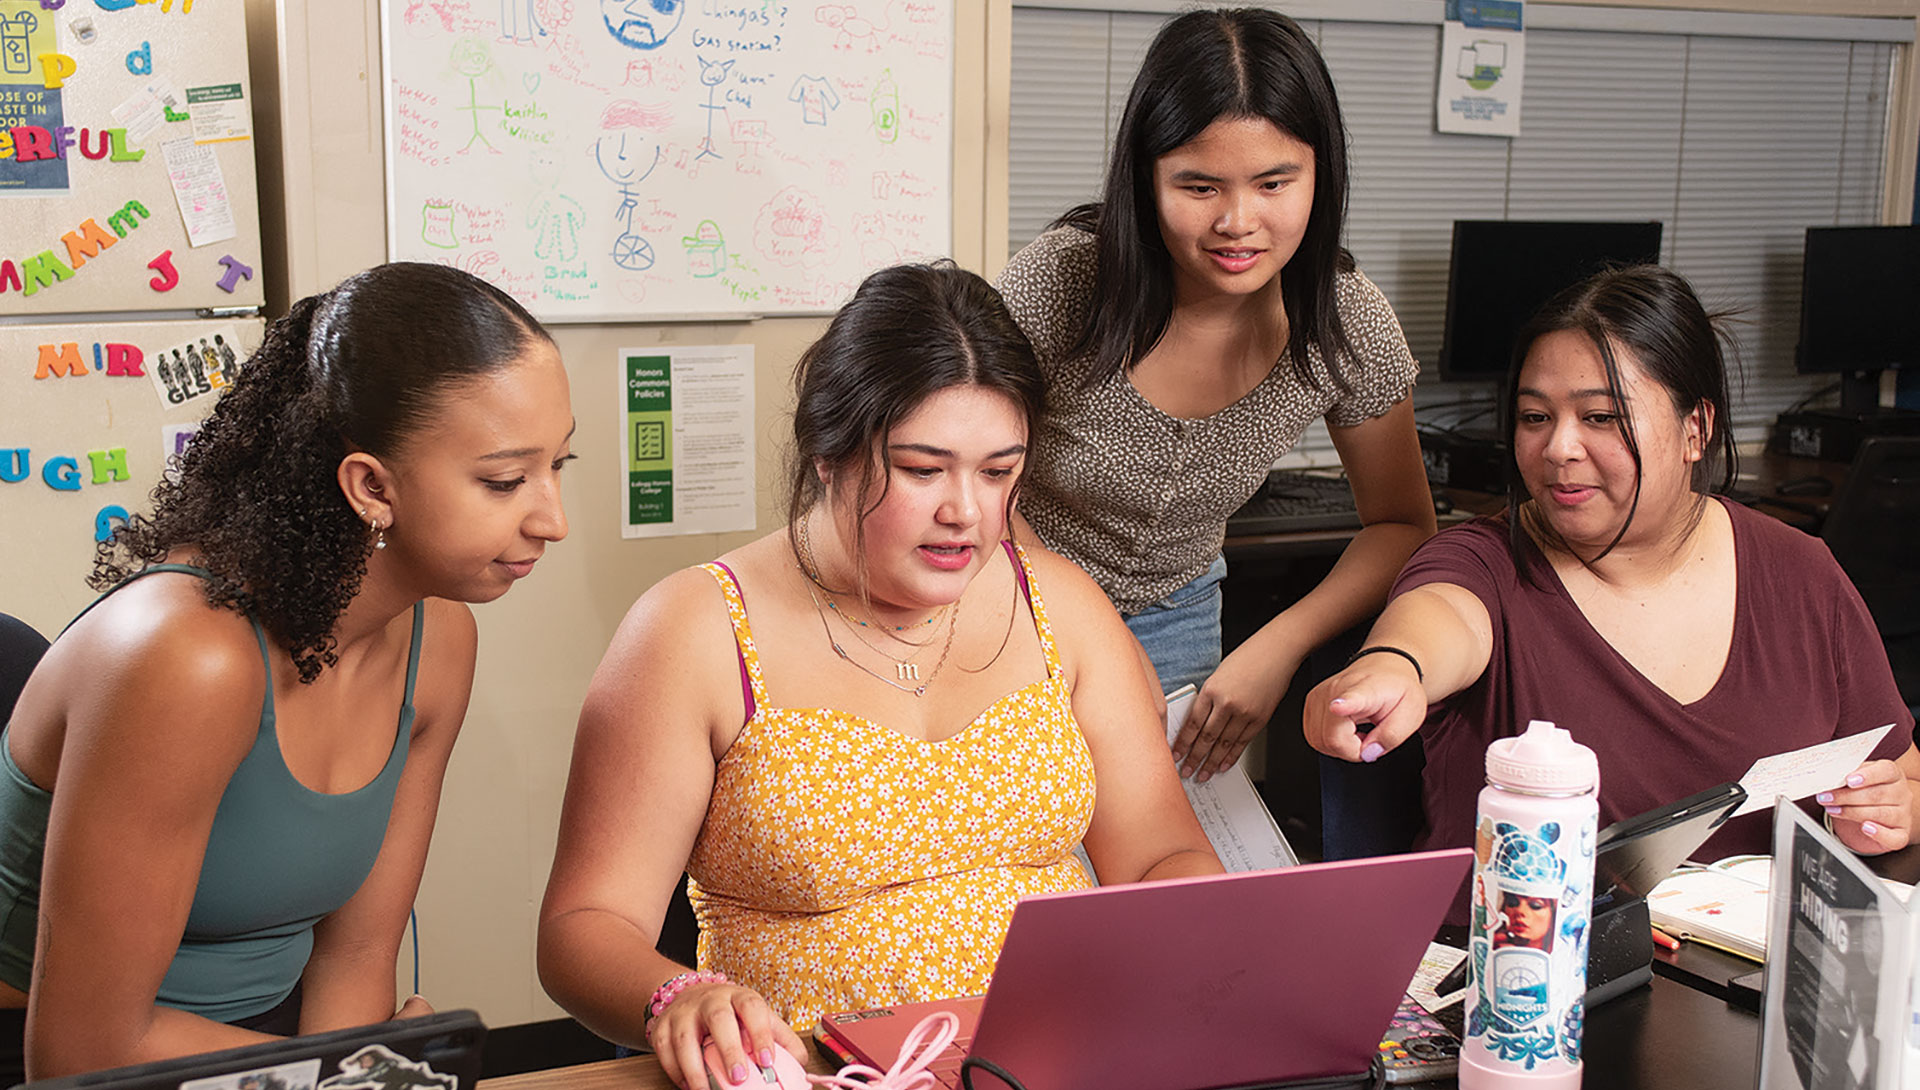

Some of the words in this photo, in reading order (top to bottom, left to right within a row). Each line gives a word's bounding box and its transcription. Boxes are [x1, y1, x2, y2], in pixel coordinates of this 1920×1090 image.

[26, 91, 44, 102] OF
[32, 104, 47, 115] IN
[635, 368, 664, 378] Honors
[629, 379, 671, 389] Commons
[634, 389, 665, 400] Policies
[1801, 849, 1818, 883] WE
[1816, 866, 1838, 902] ARE
[1800, 882, 1849, 955] HIRING
